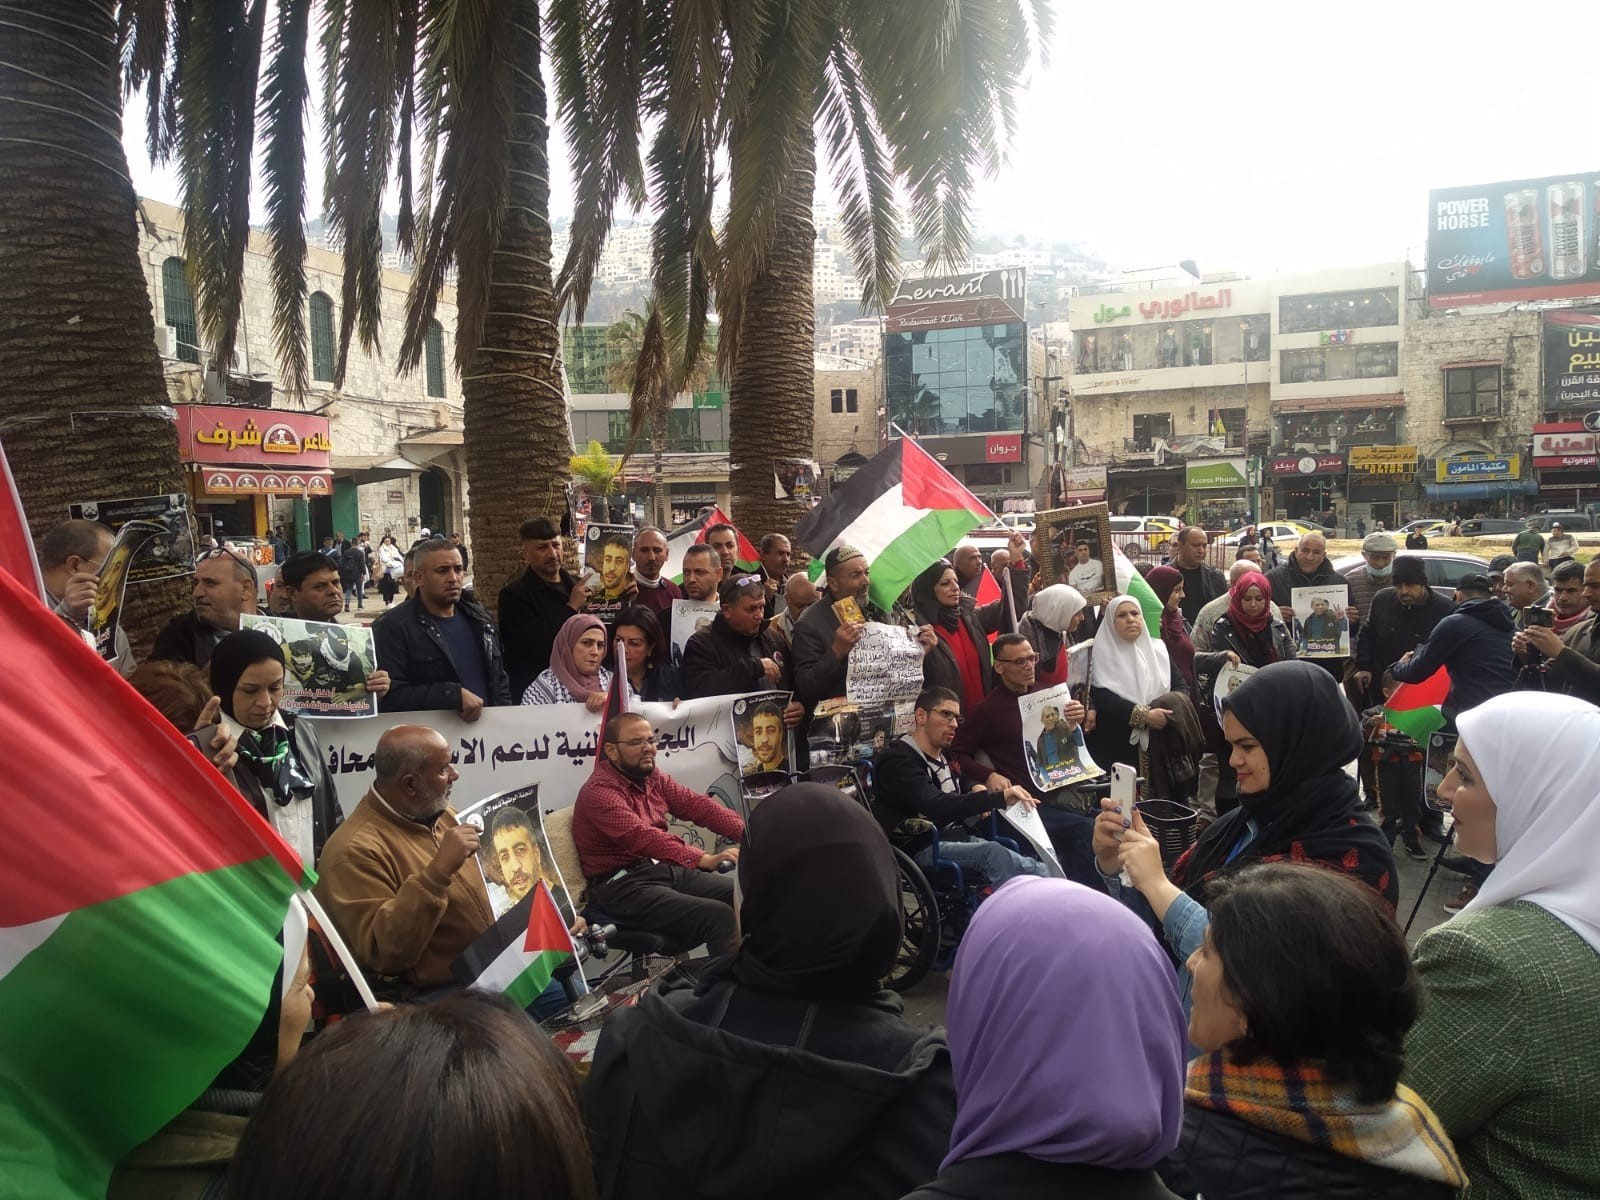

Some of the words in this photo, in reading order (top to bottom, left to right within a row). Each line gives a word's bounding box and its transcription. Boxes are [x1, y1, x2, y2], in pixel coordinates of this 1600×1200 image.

[1437, 198, 1489, 216] POWER
[1437, 213, 1489, 231] HORSE
[1566, 220, 1578, 256] HORSE
[889, 271, 990, 306] Levant
[1093, 303, 1132, 324] مول
[1561, 375, 1585, 388] القرن
[1561, 389, 1591, 400] البحرين
[196, 418, 263, 452] شرف
[1318, 459, 1342, 468] مستر
[1480, 462, 1506, 473] مكتبة
[1190, 477, 1214, 485] Access
[1214, 475, 1238, 483] Phone
[655, 724, 695, 758] اللجن
[492, 734, 550, 771] لدعم
